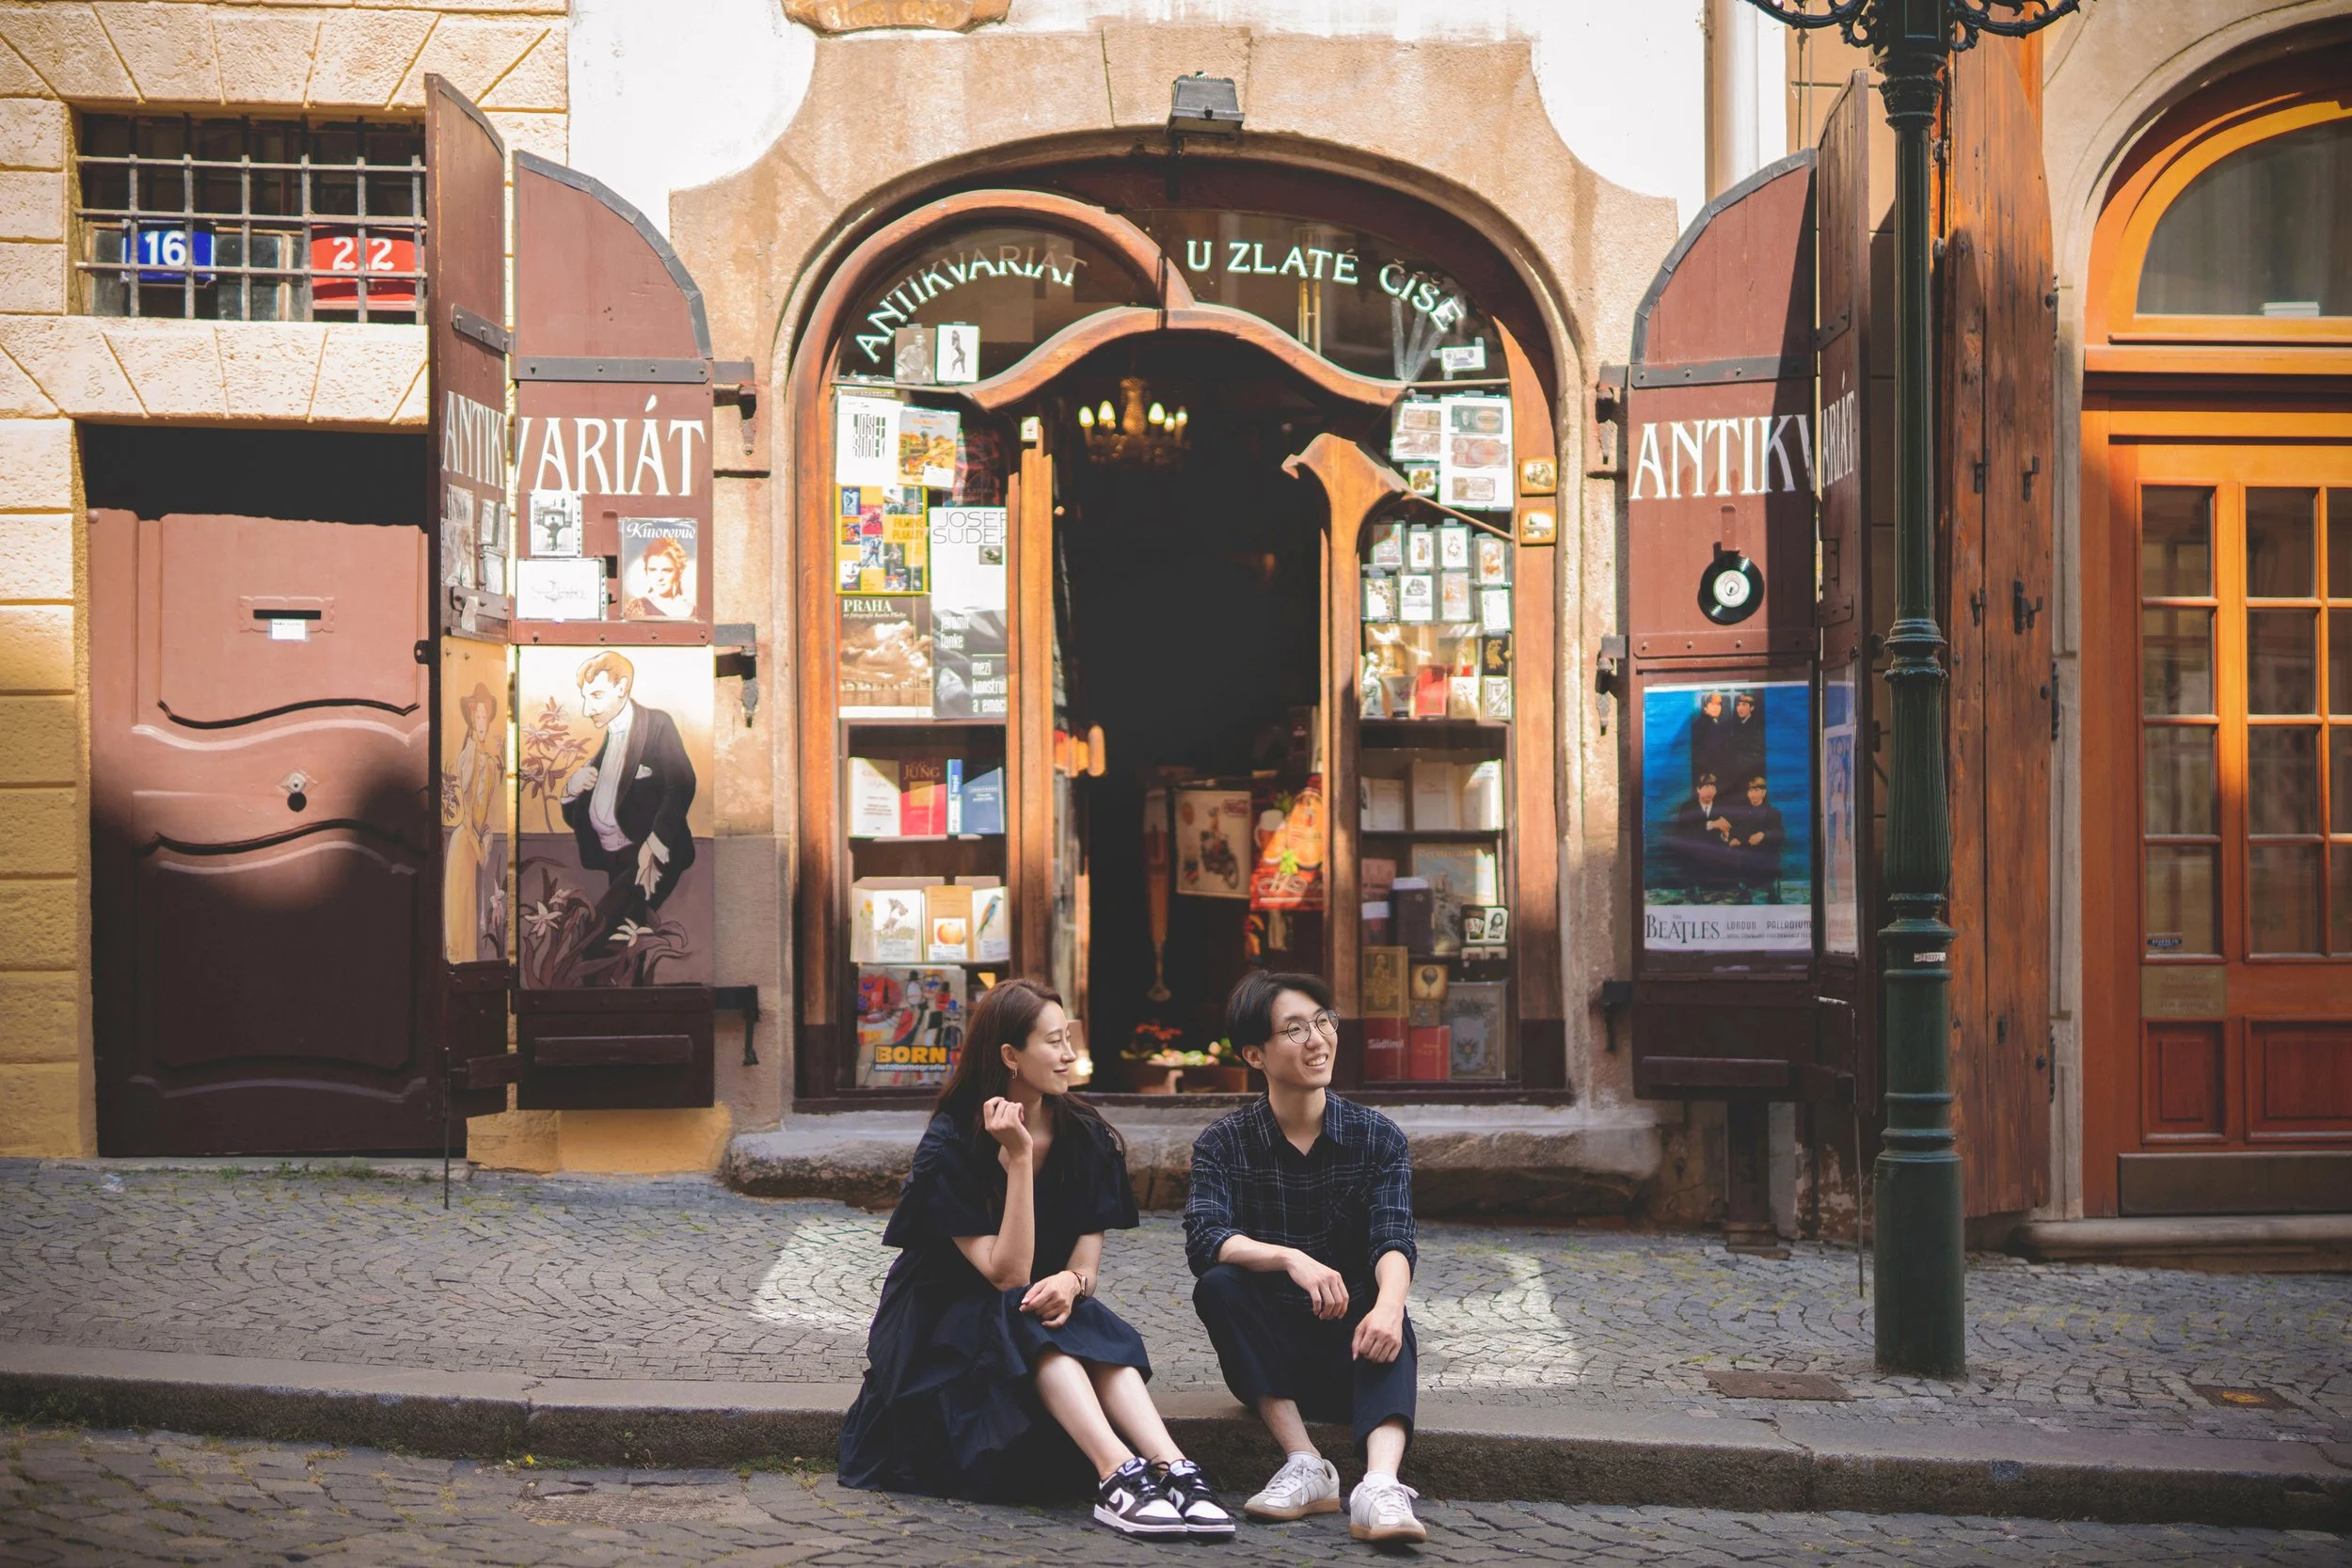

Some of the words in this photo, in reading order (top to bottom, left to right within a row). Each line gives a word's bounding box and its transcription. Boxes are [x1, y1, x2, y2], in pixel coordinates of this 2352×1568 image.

[144, 230, 187, 266] 16
[332, 235, 395, 271] 22
[1186, 240, 1213, 272] U
[625, 520, 697, 540] Kinorevue
[842, 598, 893, 612] PRAHA
[972, 659, 993, 675] mezi
[972, 699, 979, 713] a
[904, 764, 941, 780] JUNG
[1646, 913, 1721, 944] BEATLES
[1726, 920, 1757, 930] LONDON
[1766, 920, 1812, 930] PALLADIUM
[875, 1045, 947, 1064] BORN
